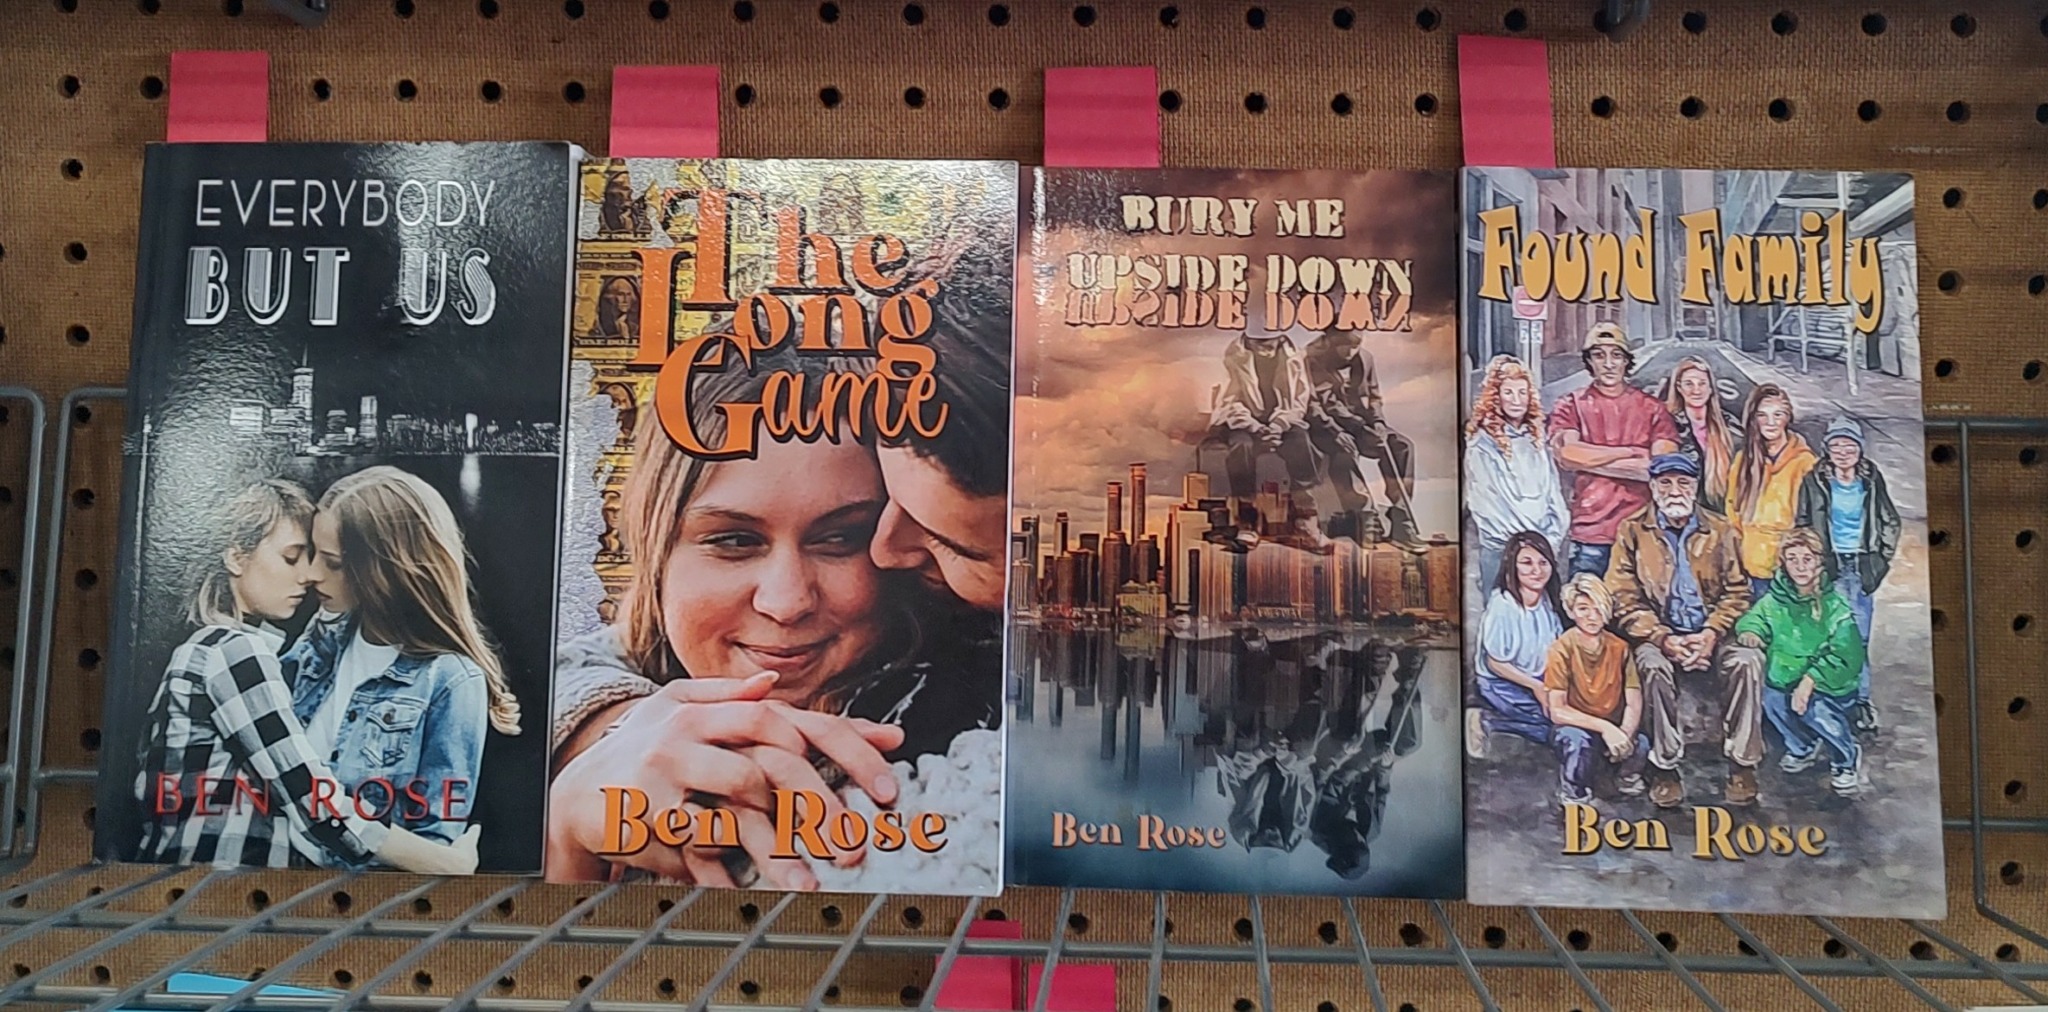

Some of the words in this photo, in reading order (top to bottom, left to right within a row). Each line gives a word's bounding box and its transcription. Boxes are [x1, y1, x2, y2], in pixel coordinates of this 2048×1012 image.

[196, 179, 496, 227] EVERYBODY
[1120, 194, 1258, 237] BURY
[1275, 199, 1345, 237] ME
[660, 187, 911, 308] The
[1066, 253, 1248, 292] UPSIDE
[1265, 255, 1414, 295] DOWN
[1478, 204, 1659, 304] Found
[1678, 206, 1882, 333] Family
[184, 246, 350, 326] BUT
[399, 246, 498, 327] US
[626, 277, 940, 380] Long
[655, 333, 950, 458] Game
[154, 771, 269, 816] BEN
[310, 776, 470, 821] ROSE
[599, 786, 740, 854] Ben
[769, 789, 949, 861] Rose
[1051, 812, 1123, 848] Ben
[1137, 814, 1226, 851] Rose
[1561, 803, 1673, 855] Ben
[1692, 806, 1826, 861] Rose
